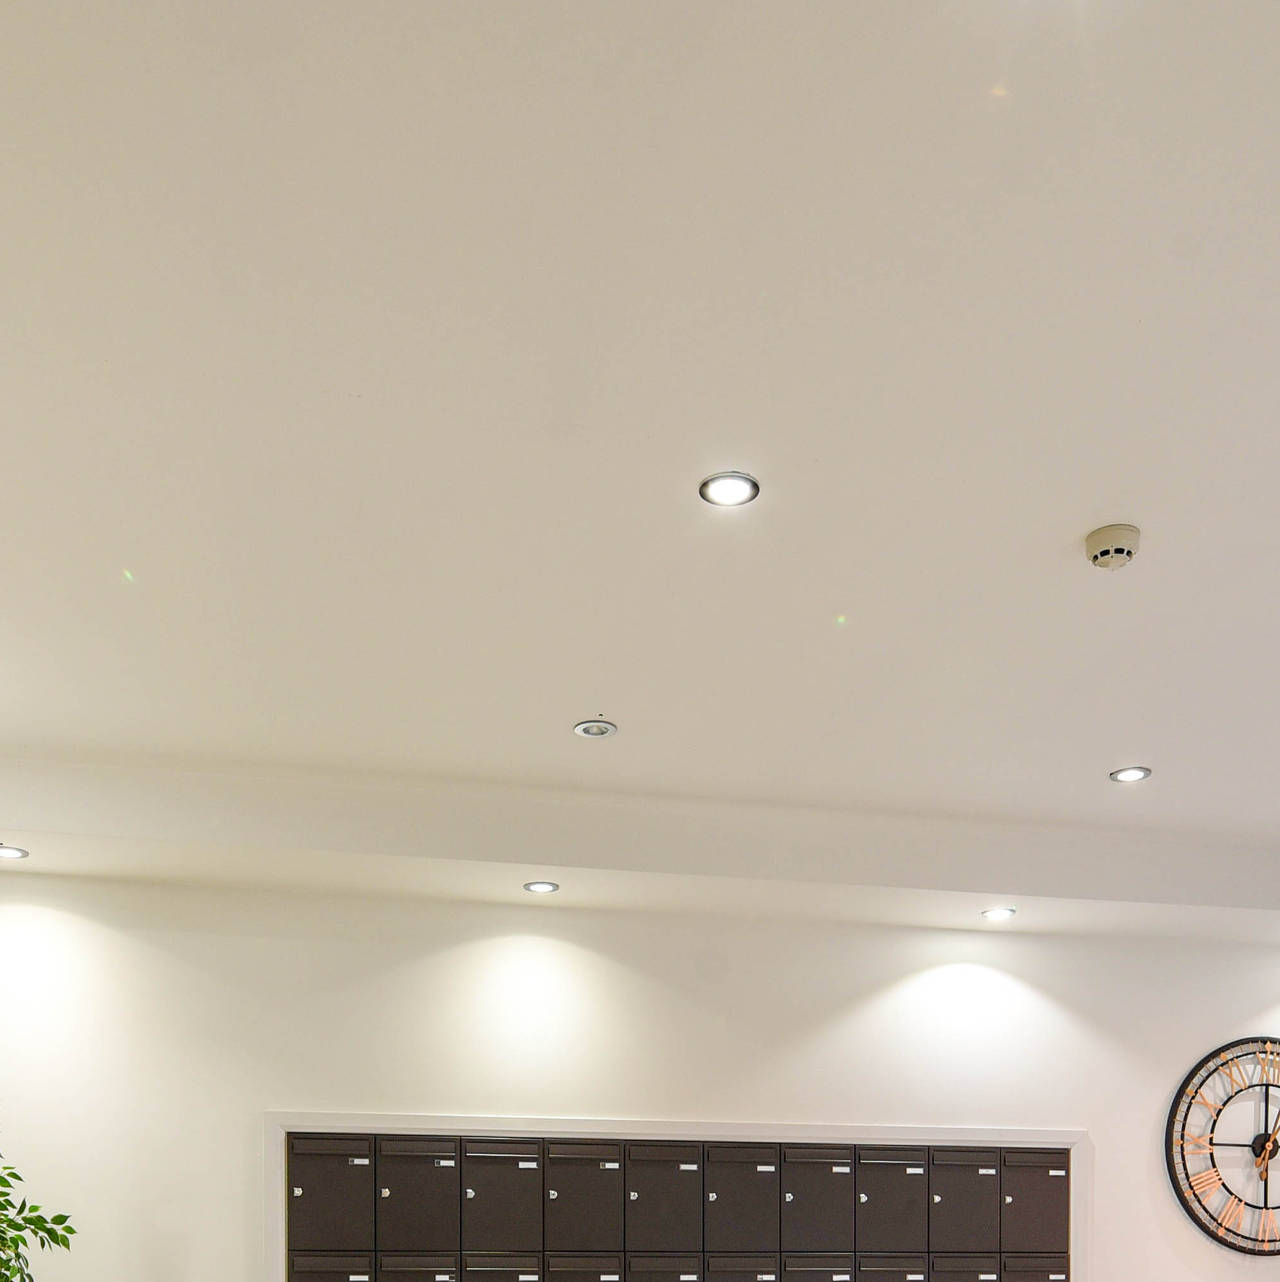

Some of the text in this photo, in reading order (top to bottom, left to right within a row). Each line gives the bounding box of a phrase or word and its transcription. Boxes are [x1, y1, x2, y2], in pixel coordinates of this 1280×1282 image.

[1218, 1058, 1248, 1096] XI
[1191, 1089, 1224, 1120] X
[1183, 1130, 1214, 1155] IX
[1189, 1167, 1223, 1204] VIII
[1217, 1194, 1246, 1233] VII
[1258, 1208, 1280, 1241] VI
